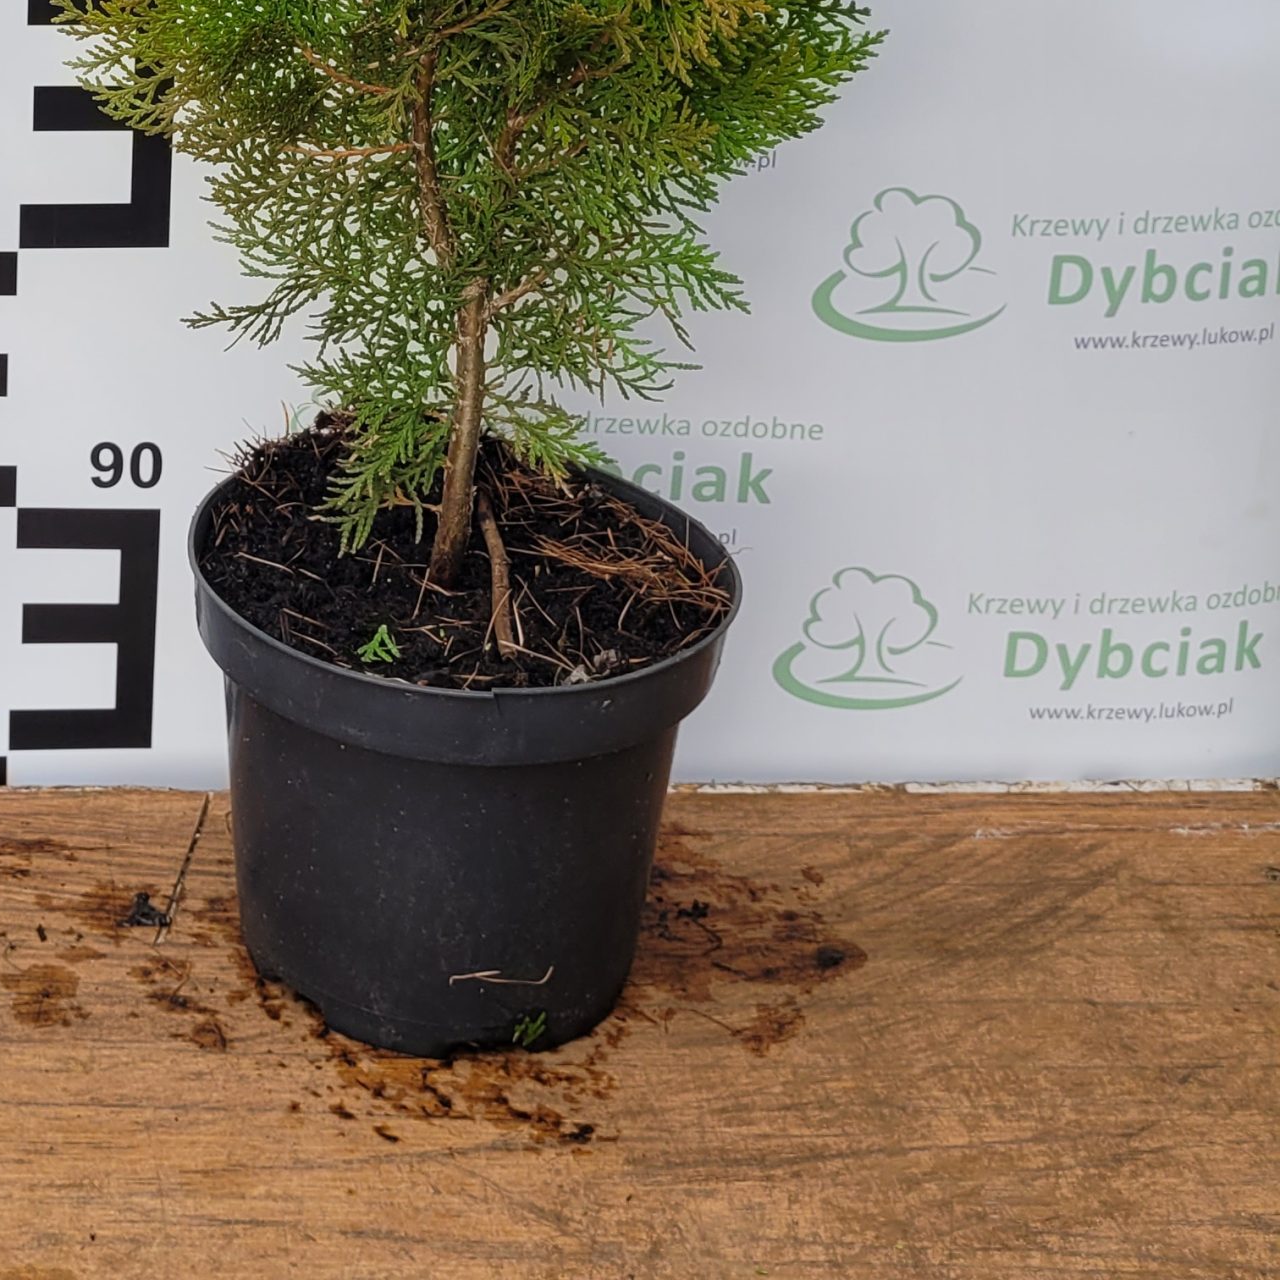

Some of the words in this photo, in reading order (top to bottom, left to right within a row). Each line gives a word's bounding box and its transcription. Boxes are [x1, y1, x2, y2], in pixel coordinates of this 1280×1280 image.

[1011, 214, 1110, 241] Krzewy
[1118, 212, 1125, 235] i
[1133, 207, 1240, 235] drzewka
[1074, 323, 1274, 350] www.krzewy.lukow.pl
[701, 416, 824, 441] ozdobne
[90, 441, 163, 489] 90
[968, 593, 1065, 620] Krzewy
[1073, 594, 1081, 614] i
[1089, 591, 1197, 615] drzewka
[1003, 620, 1264, 690] Dybciak
[1029, 698, 1234, 722] www.krzewy.lukow.pl
